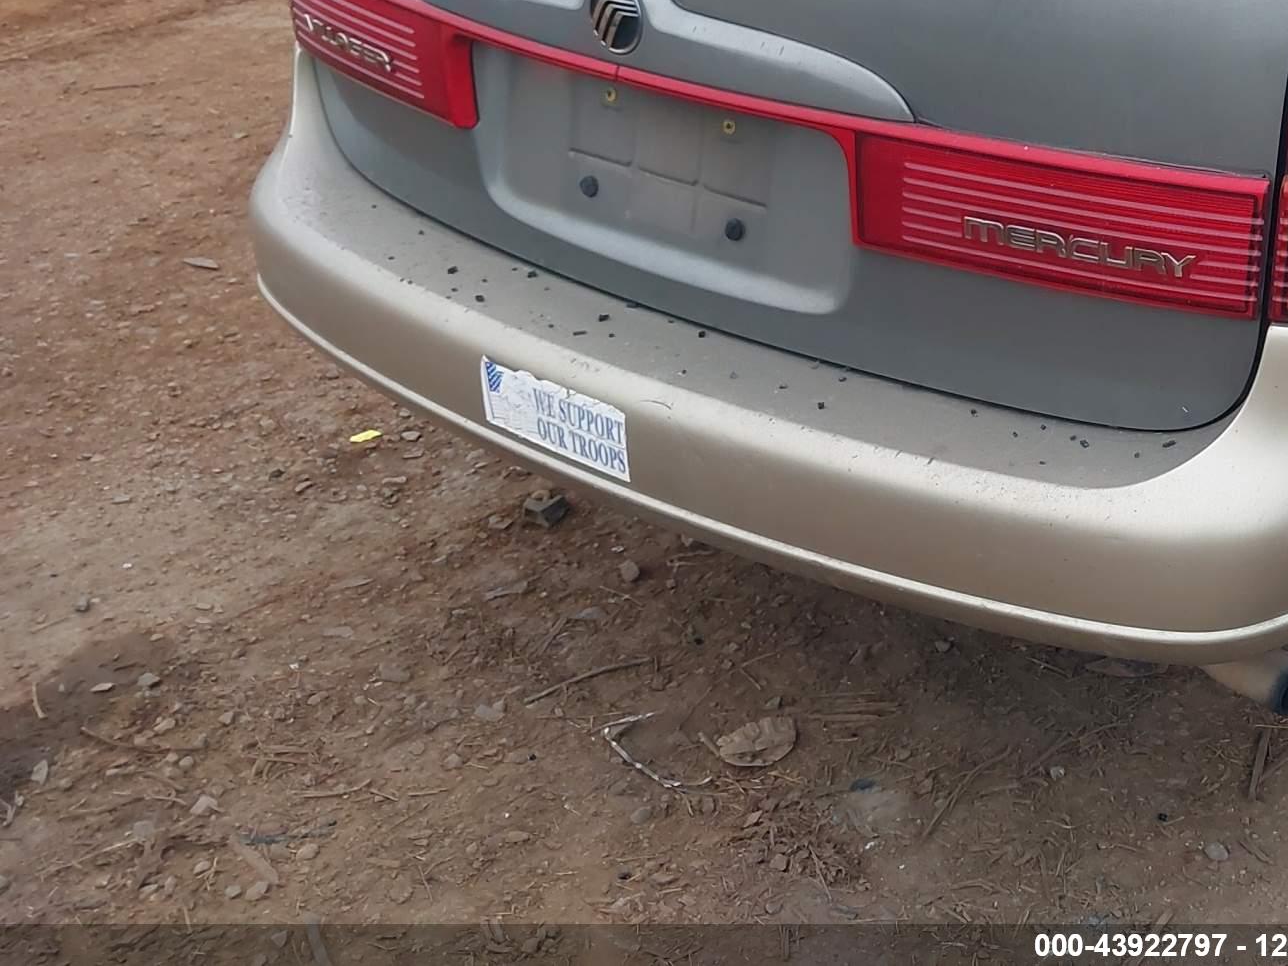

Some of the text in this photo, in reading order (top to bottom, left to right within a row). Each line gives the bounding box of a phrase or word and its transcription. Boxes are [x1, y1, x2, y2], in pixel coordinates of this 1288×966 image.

[963, 216, 1196, 277] MERCURY
[533, 388, 624, 445] WE SUPPORT
[537, 418, 626, 474] OUR TROOPS
